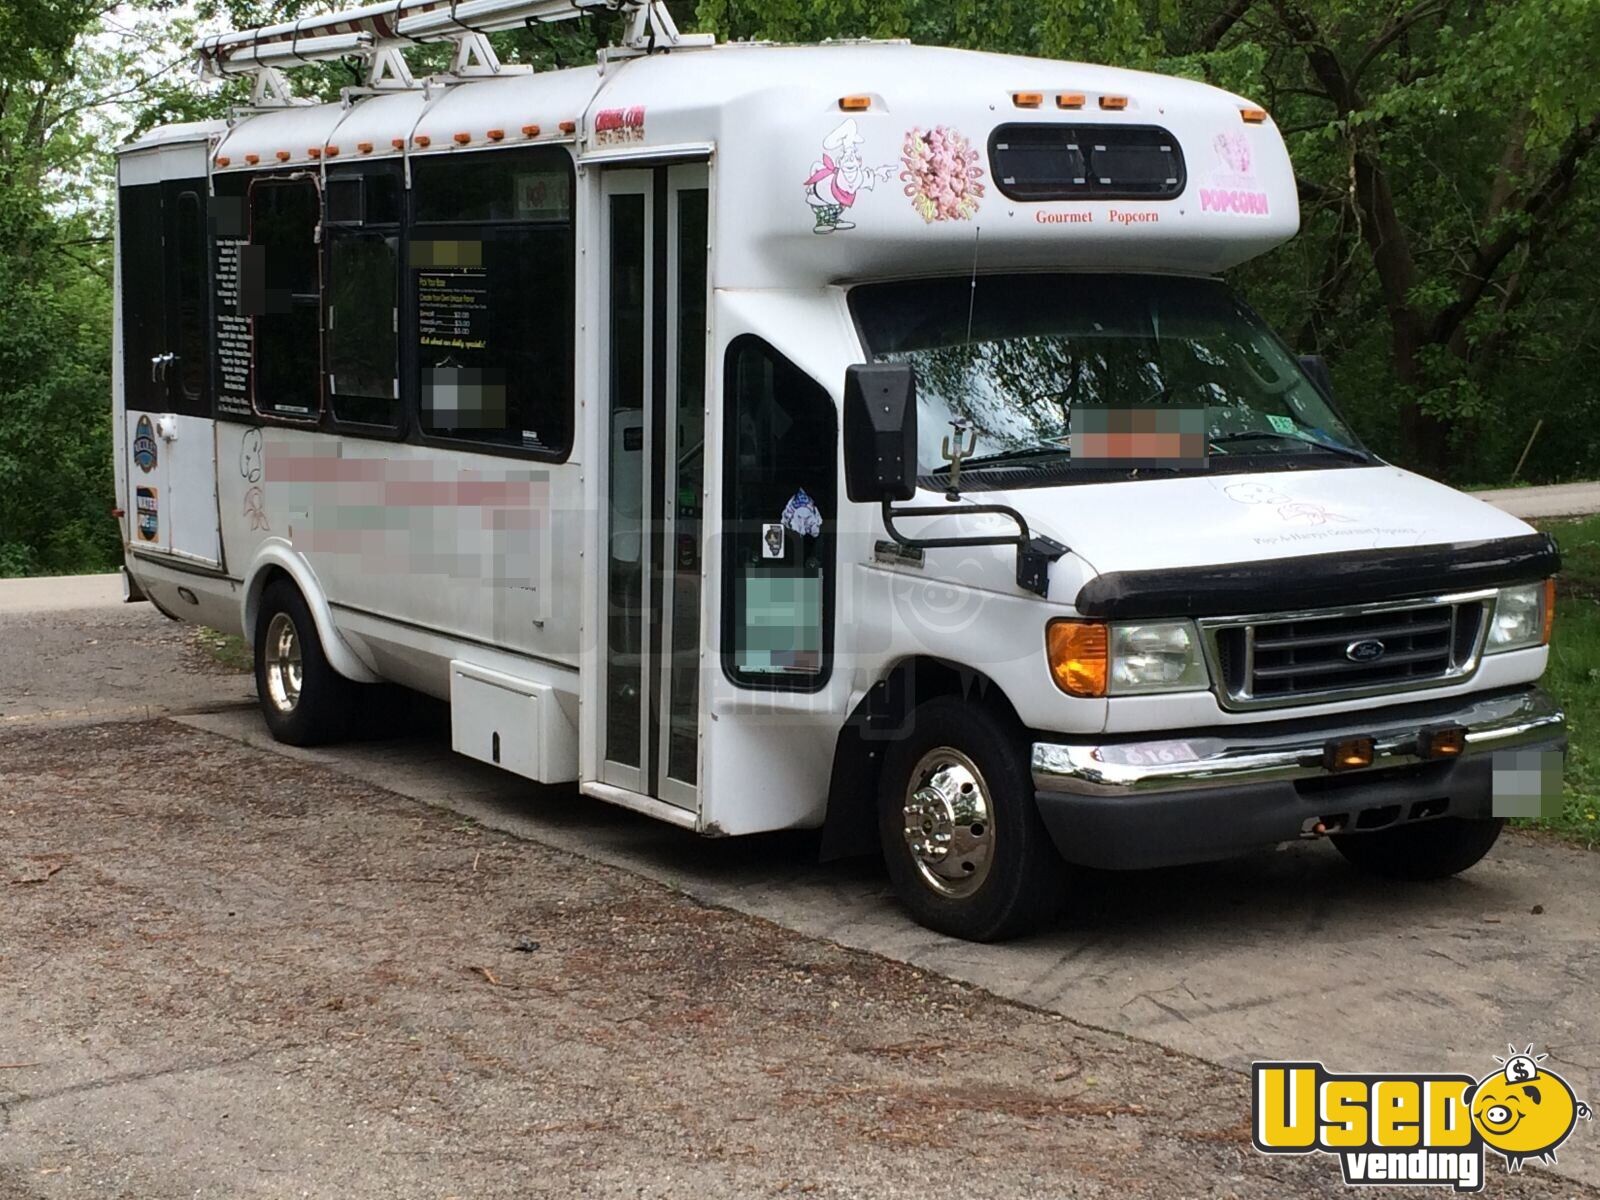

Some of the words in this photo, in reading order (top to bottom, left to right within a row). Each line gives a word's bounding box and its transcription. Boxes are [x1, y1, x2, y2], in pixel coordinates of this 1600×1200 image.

[1199, 188, 1269, 215] POPCORN
[1035, 209, 1093, 224] Gourmet
[1109, 209, 1159, 225] Popcorn
